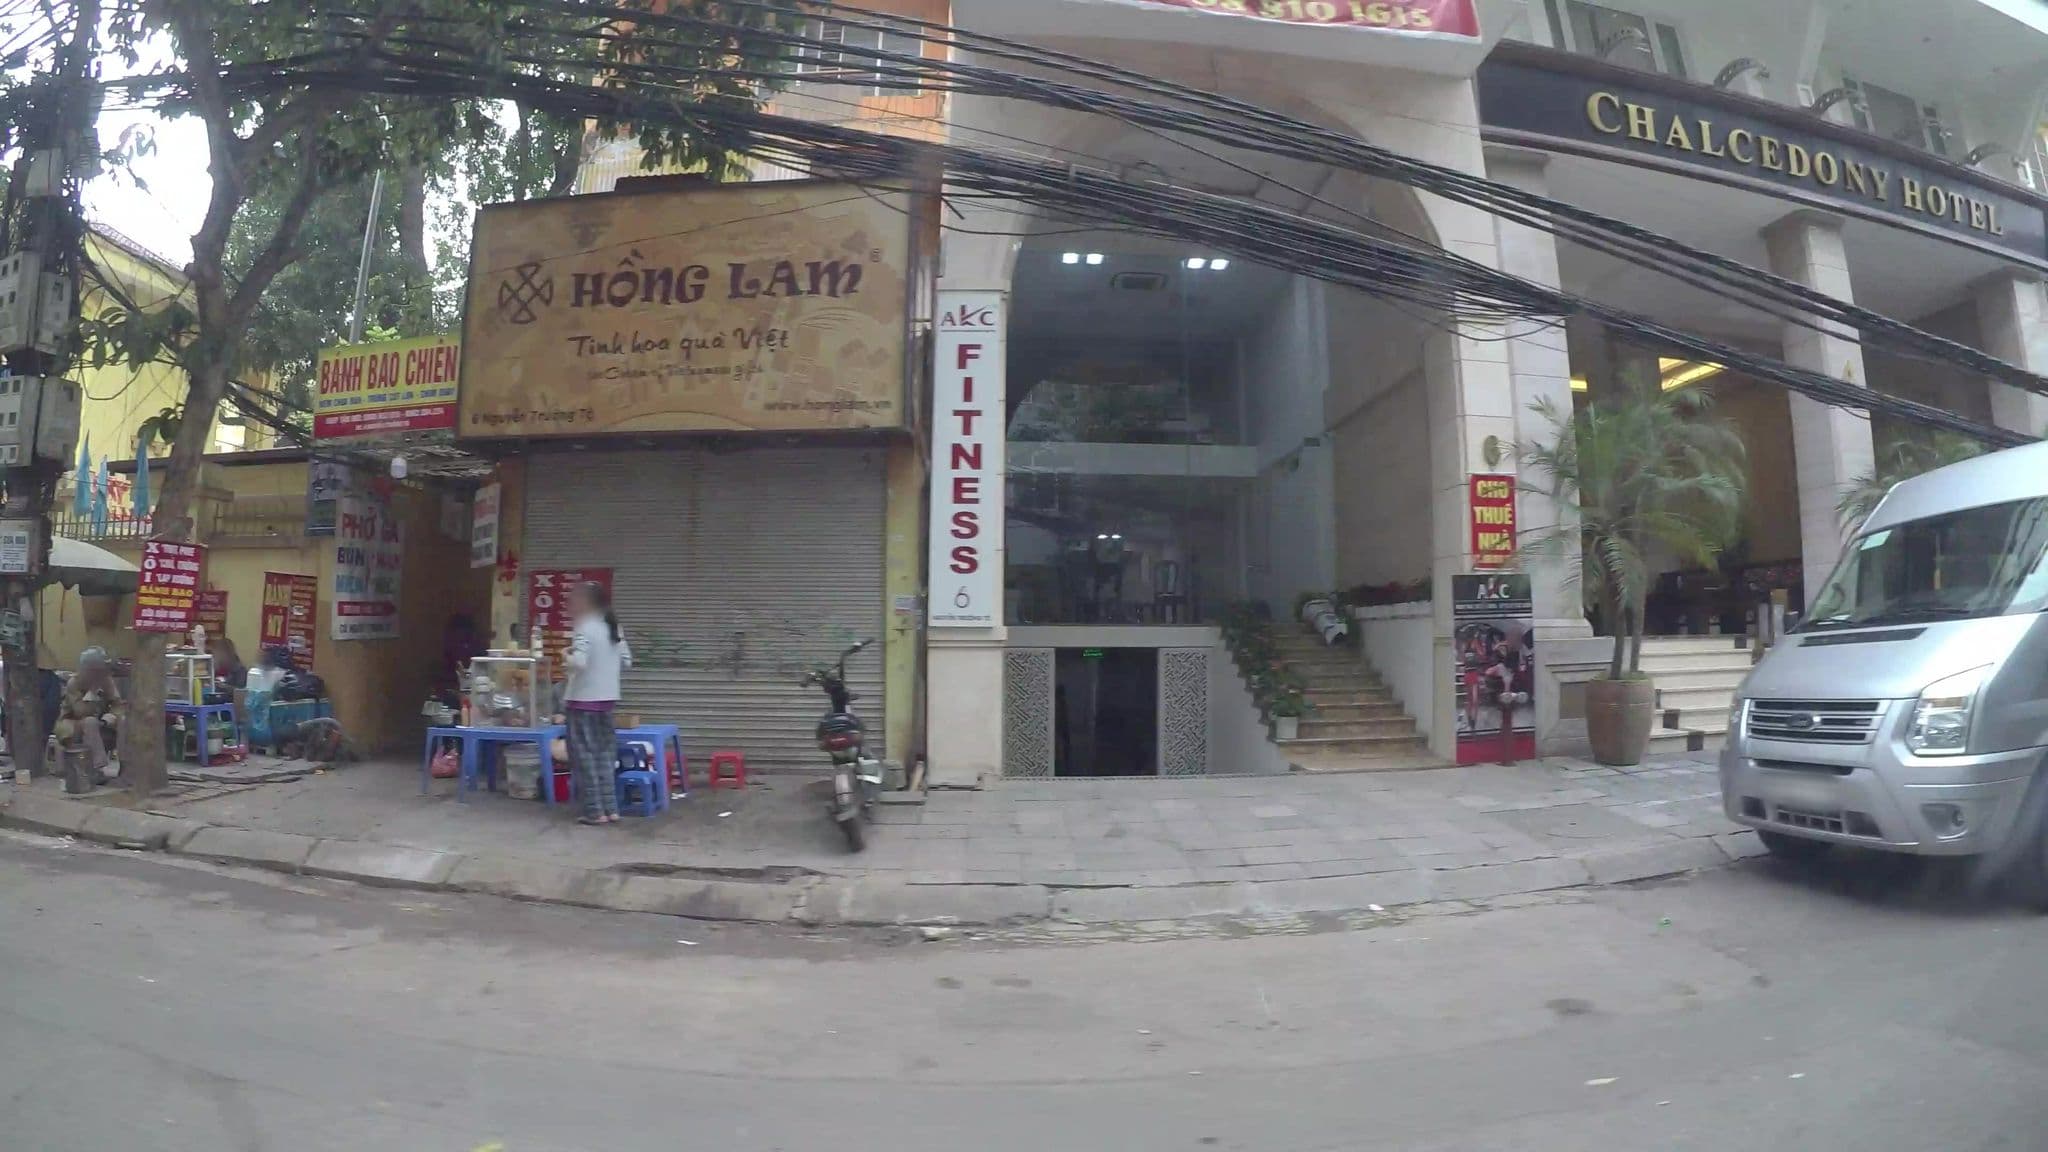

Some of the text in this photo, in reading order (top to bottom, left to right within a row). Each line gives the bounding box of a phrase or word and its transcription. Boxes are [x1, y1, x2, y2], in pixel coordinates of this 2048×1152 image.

[1587, 92, 2003, 235] CHALCEDONY HOTEL
[570, 249, 863, 308] HỒNG LAM
[940, 305, 995, 327] AKC
[567, 327, 790, 361] Tinh hoa quà Việt
[319, 351, 365, 395] BÁNH
[367, 351, 400, 390] BAO
[950, 343, 983, 575] FITNESS
[1476, 480, 1510, 499] CHO
[1473, 503, 1513, 525] THUÊ
[1478, 530, 1512, 551] NHÀ
[954, 585, 971, 609] 6
